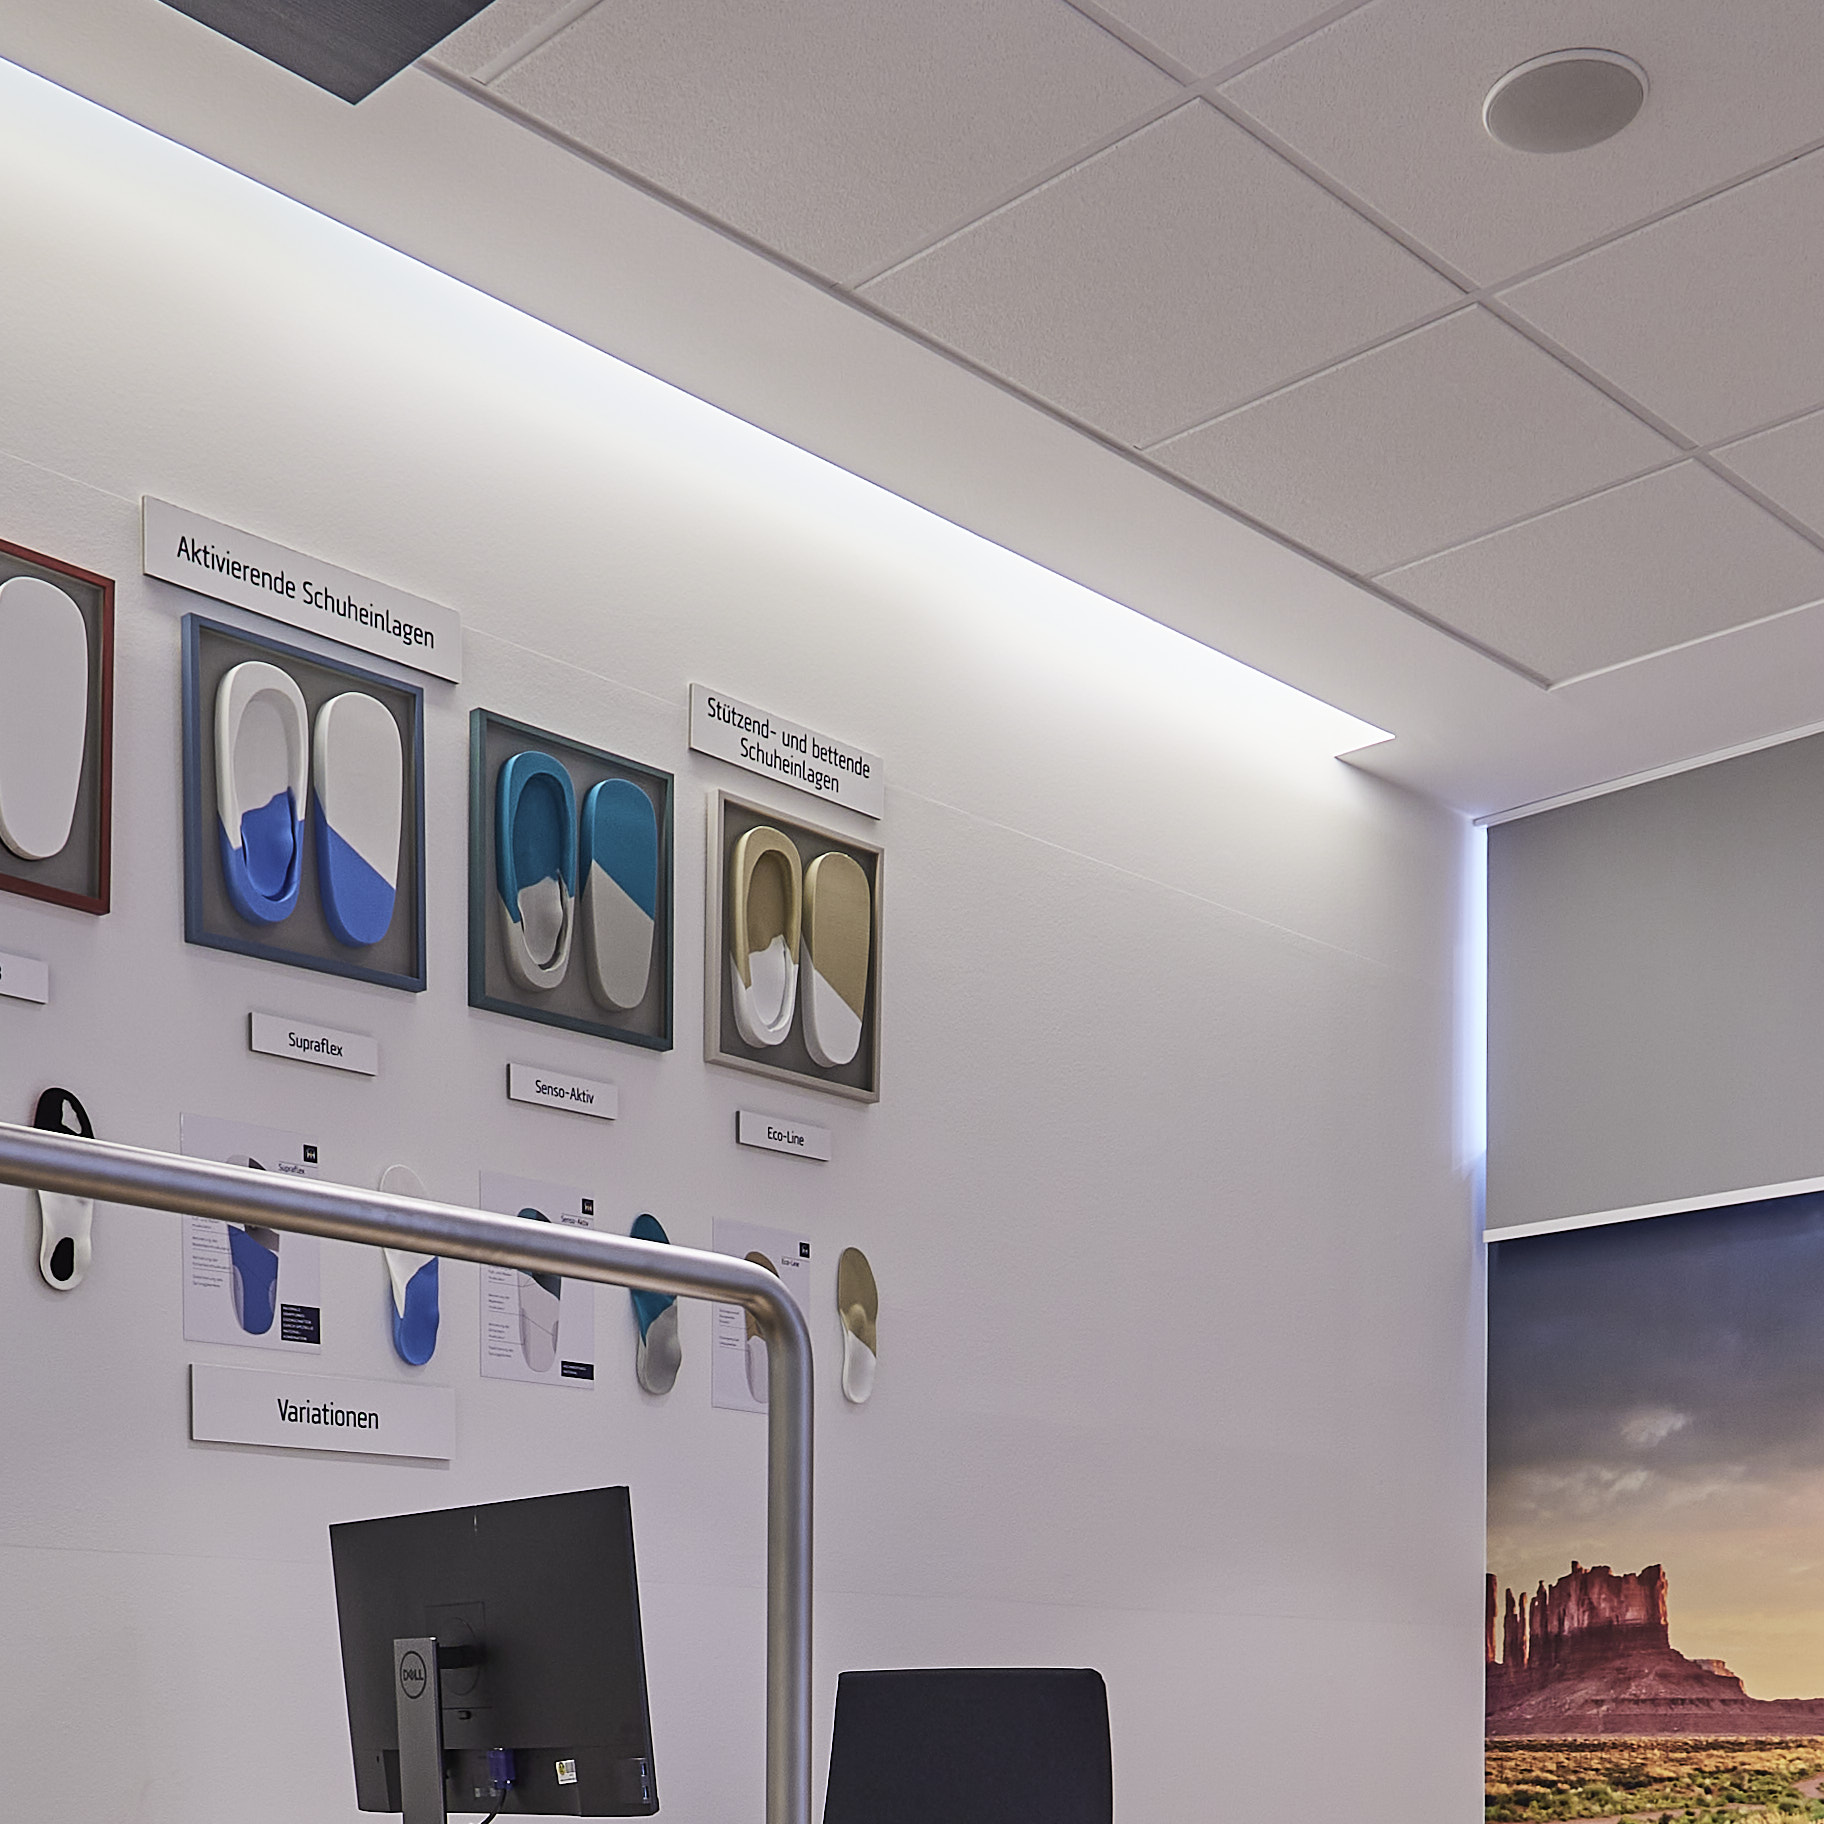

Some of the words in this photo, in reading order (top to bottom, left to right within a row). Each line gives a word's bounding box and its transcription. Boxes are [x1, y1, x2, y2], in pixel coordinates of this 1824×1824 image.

[175, 535, 296, 600] Aktivierende
[302, 581, 435, 652] Schuheinlagen
[707, 696, 778, 740] Stützend-
[782, 730, 808, 752] und
[811, 735, 871, 780] bettende
[739, 737, 840, 795] Schuheinlagen
[287, 1031, 344, 1059] Supraflex
[534, 1079, 595, 1106] Senso-Aktiv
[766, 1126, 805, 1147] Eco-Line
[277, 1398, 379, 1431] Variationen
[402, 1668, 424, 1681] DELL
